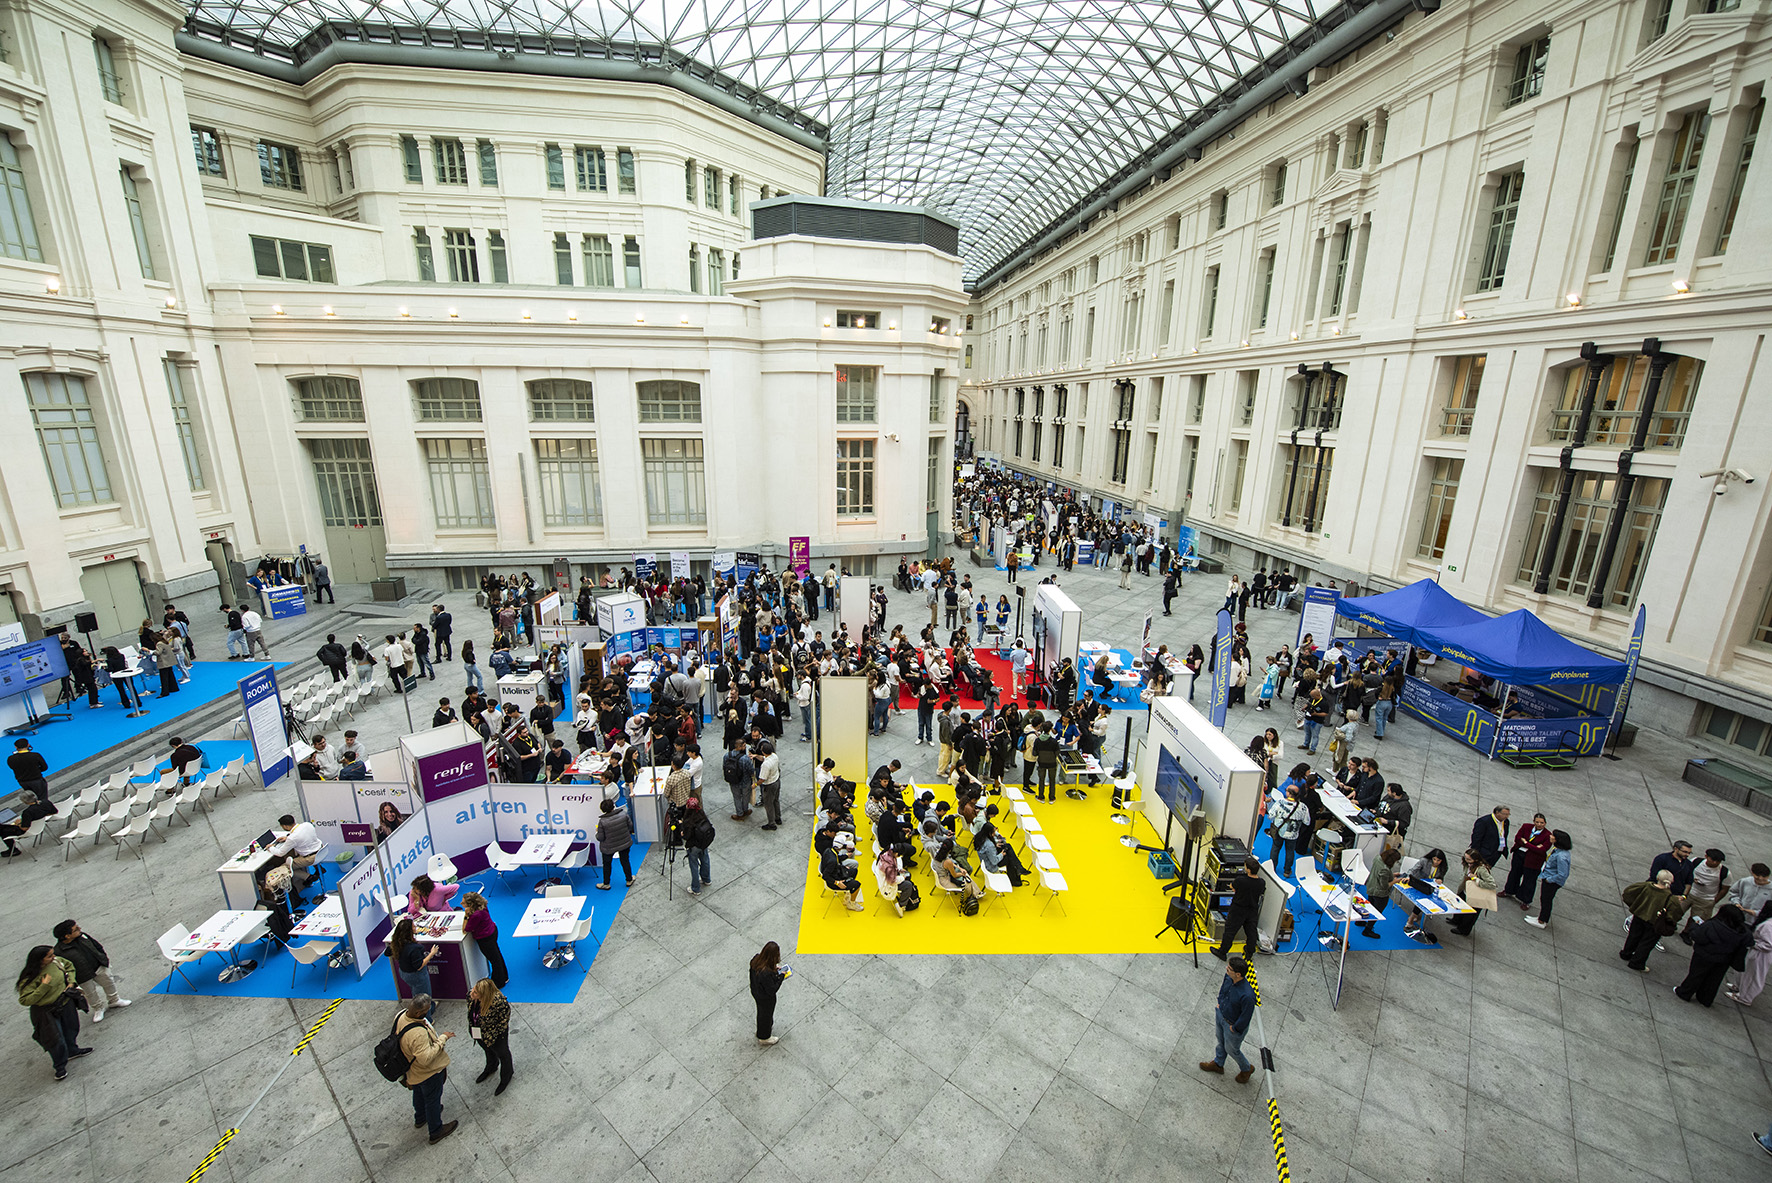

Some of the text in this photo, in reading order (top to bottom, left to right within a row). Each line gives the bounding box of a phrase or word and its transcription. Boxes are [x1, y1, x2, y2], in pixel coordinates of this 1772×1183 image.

[1441, 645, 1476, 664] jobinplanet
[1550, 671, 1590, 680] jobinplanet
[246, 682, 269, 700] ROOM
[268, 680, 273, 688] 1
[502, 687, 531, 695] Molins
[434, 761, 474, 780] renfe
[364, 788, 387, 796] cesif
[561, 793, 593, 804] renfe
[455, 799, 528, 825] al tren
[535, 809, 570, 825] del
[352, 862, 379, 890] renfe
[357, 835, 431, 917] Apúntate
